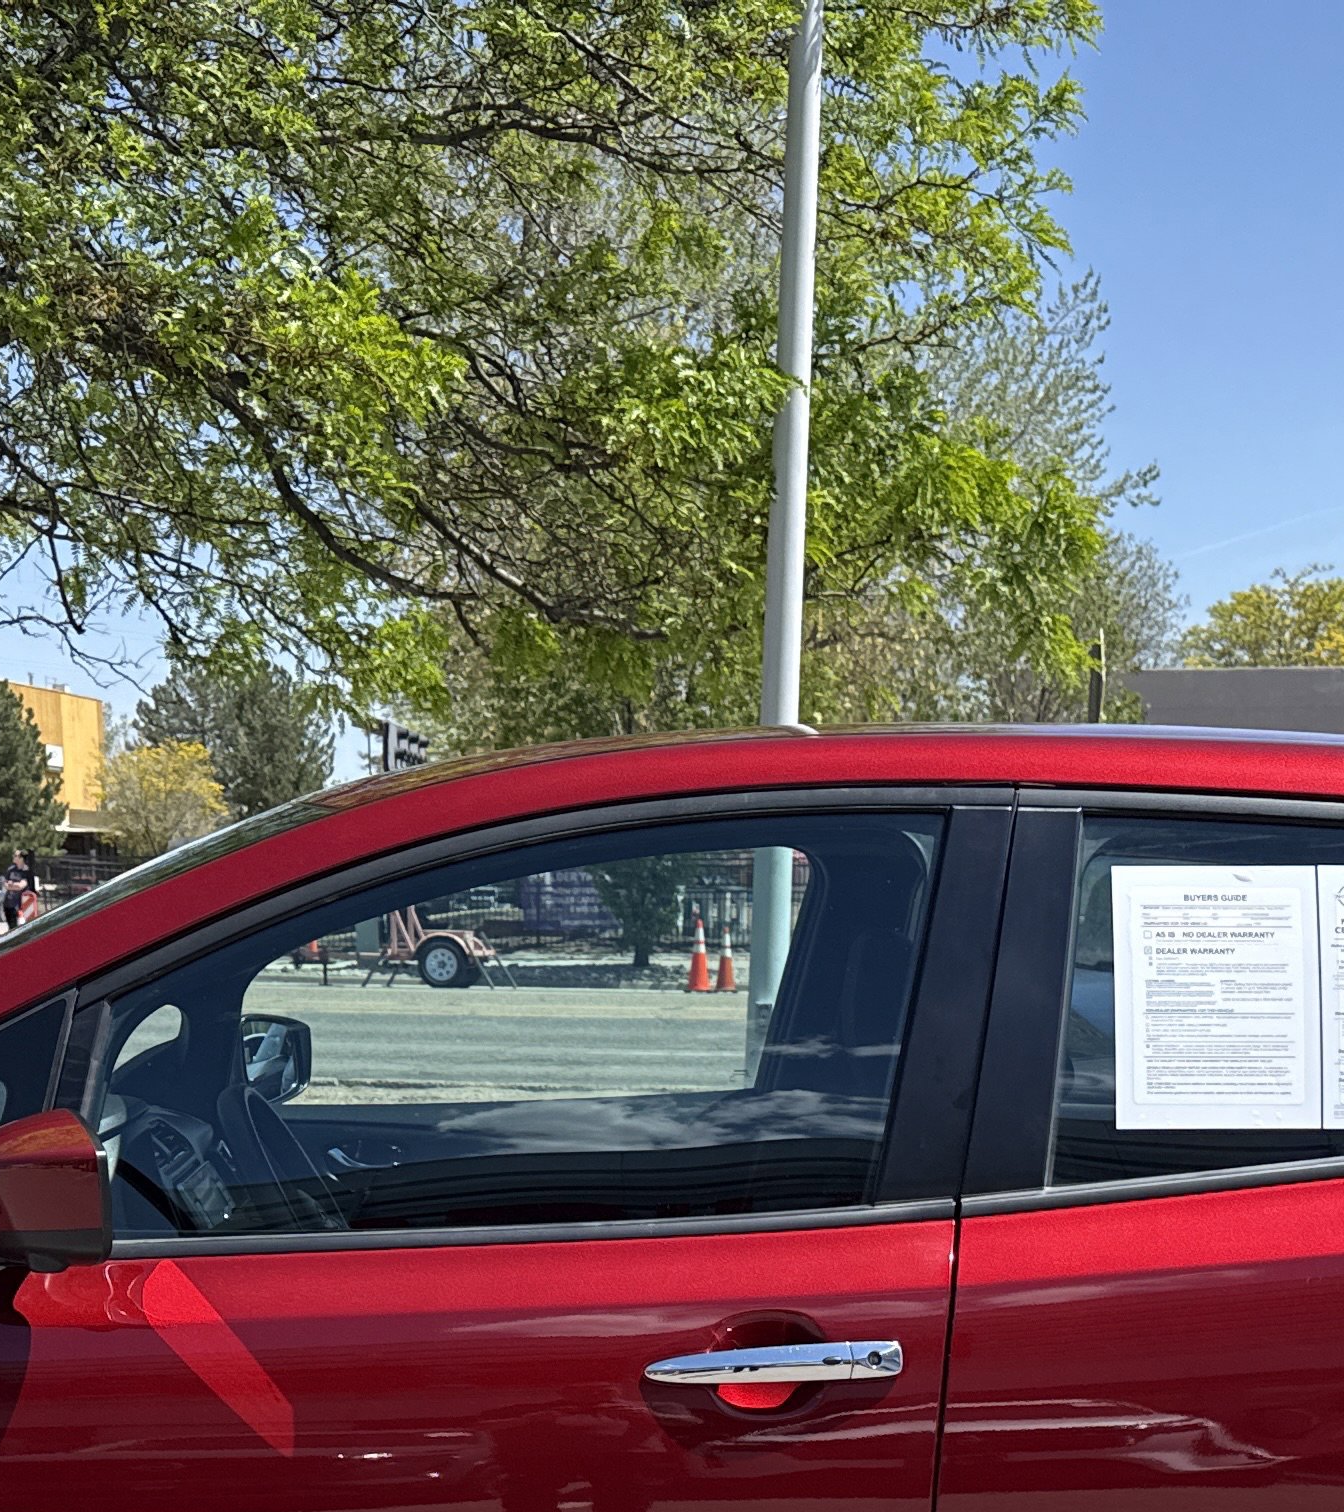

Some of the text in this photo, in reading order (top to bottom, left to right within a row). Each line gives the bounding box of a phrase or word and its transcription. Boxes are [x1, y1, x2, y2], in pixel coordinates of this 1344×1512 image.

[1183, 894, 1248, 902] BUYERS GUIDE
[1155, 947, 1236, 955] DEALER WARRANTY
